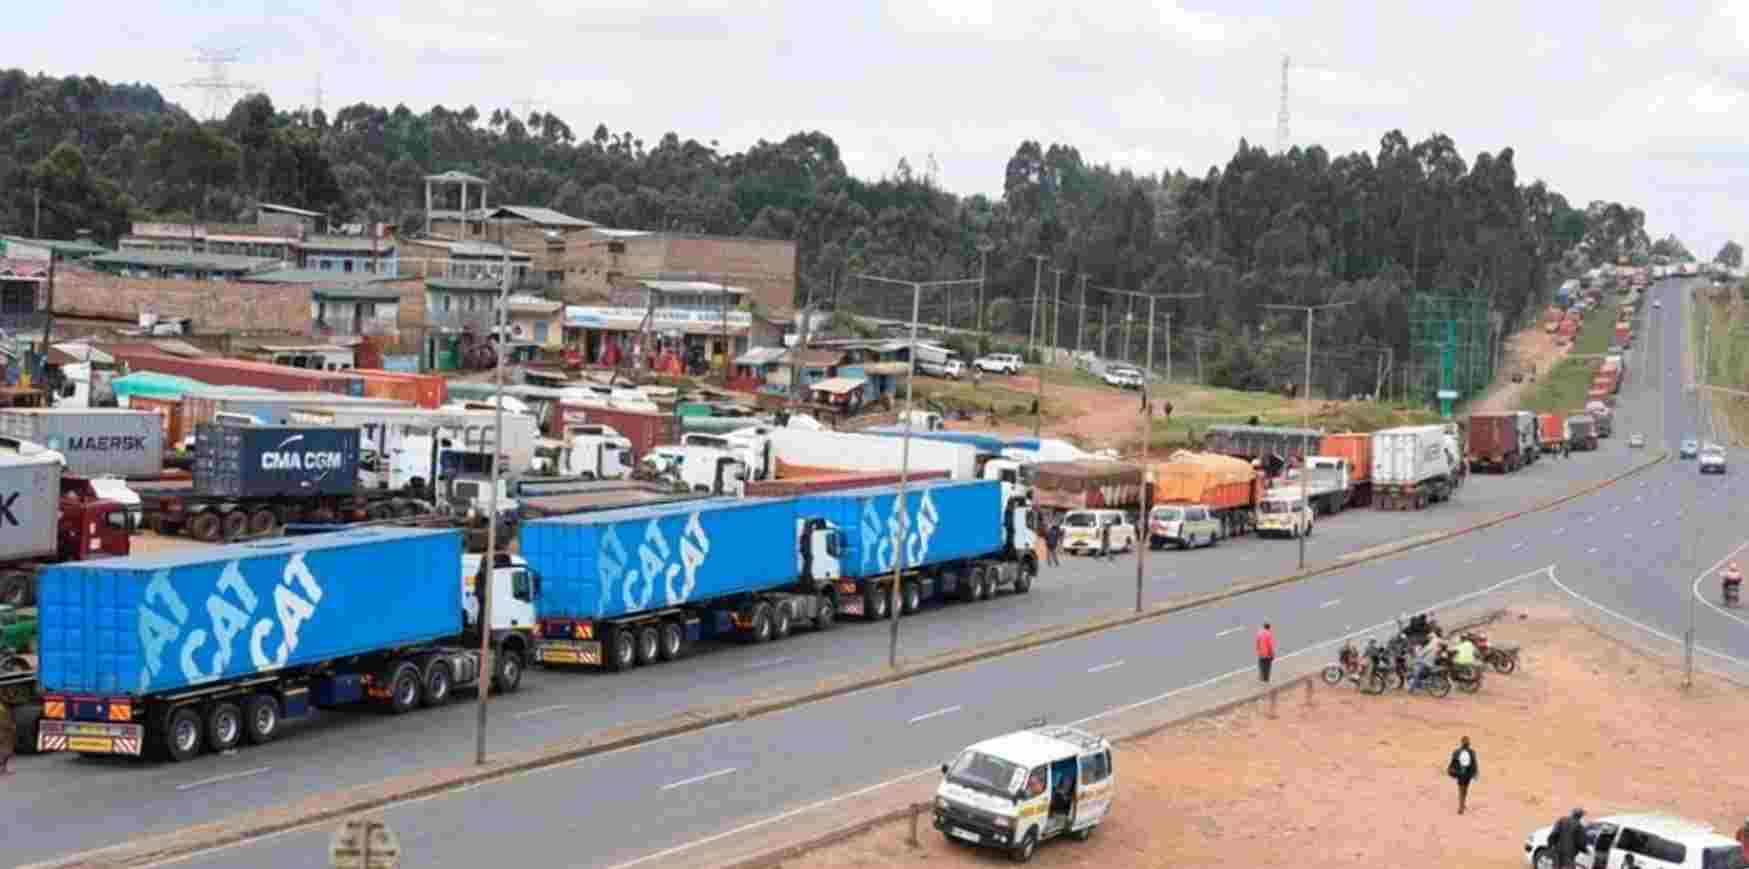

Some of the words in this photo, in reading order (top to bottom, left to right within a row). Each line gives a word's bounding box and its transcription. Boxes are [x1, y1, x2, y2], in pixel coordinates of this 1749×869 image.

[68, 435, 147, 452] MAERSK
[261, 452, 301, 470] CMA
[304, 452, 342, 470] CGM
[624, 519, 671, 612] CAT
[666, 511, 709, 605] CAT
[908, 488, 938, 567] CAT
[137, 570, 189, 694] AT
[181, 560, 259, 686] CAT
[251, 551, 323, 671] CAT
